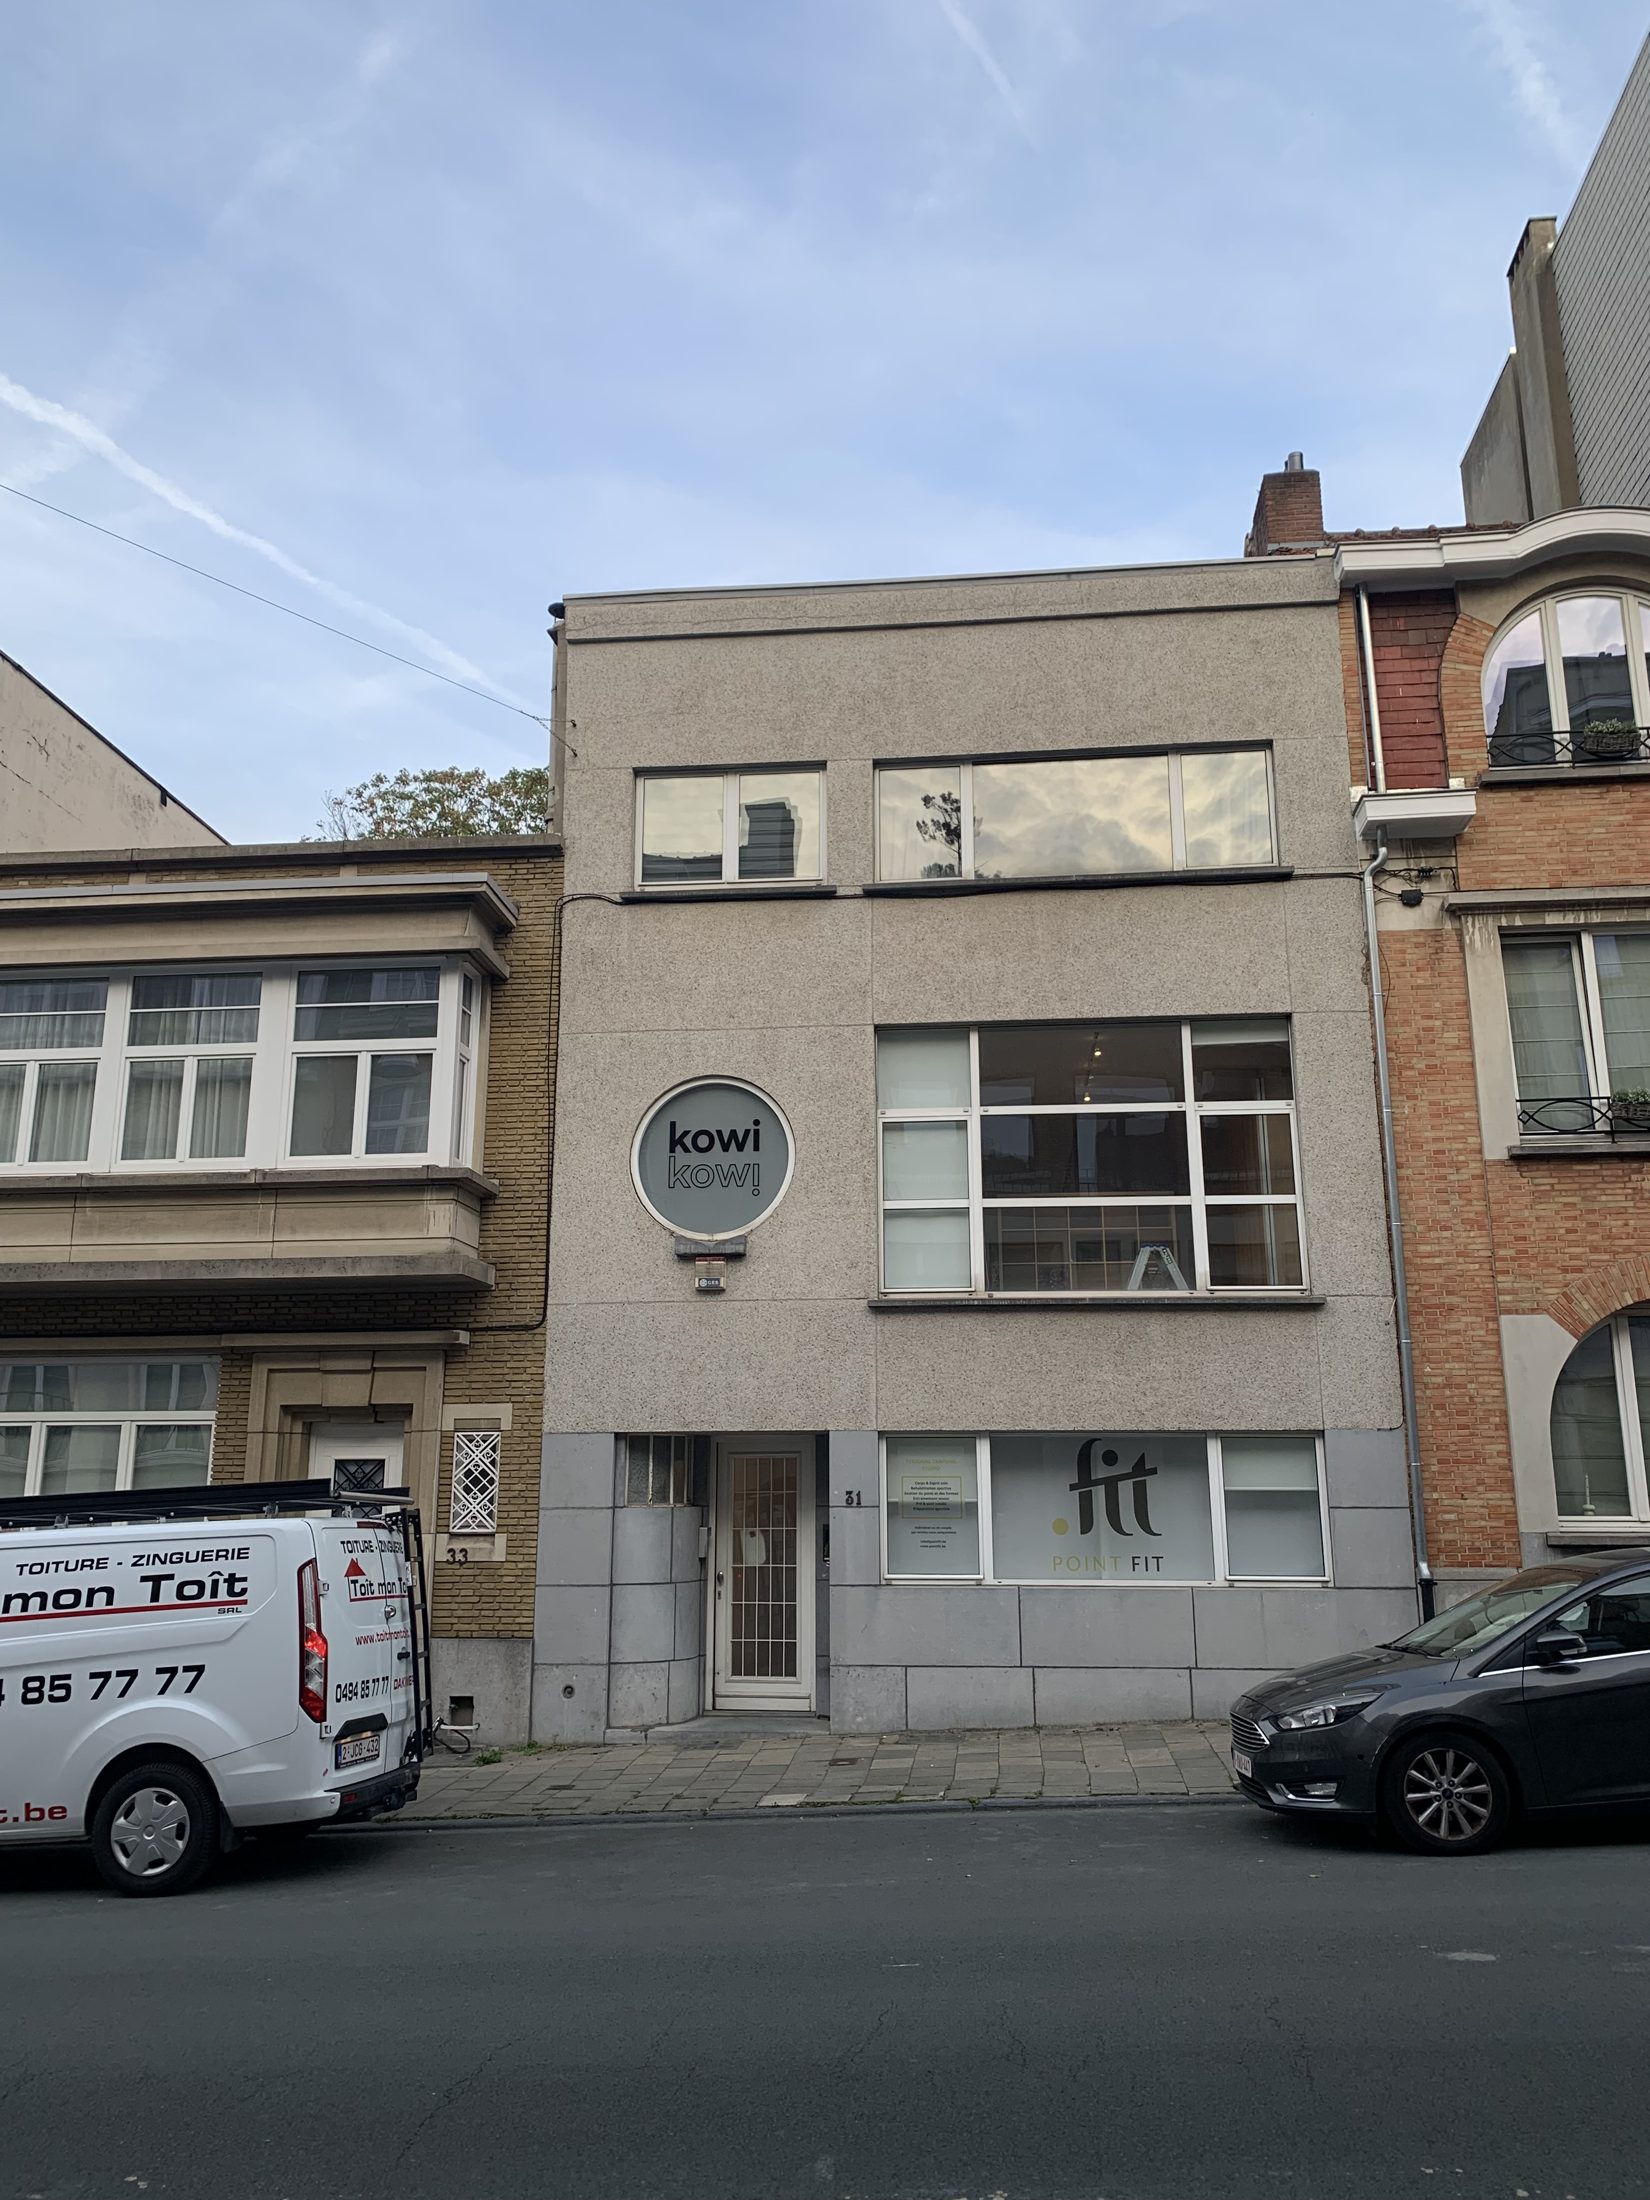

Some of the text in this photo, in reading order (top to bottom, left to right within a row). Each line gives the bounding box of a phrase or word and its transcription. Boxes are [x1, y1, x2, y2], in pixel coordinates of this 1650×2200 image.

[669, 1118, 760, 1154] kowi
[846, 1490, 861, 1505] 31
[340, 1540, 374, 1554] TOITURE
[446, 1547, 468, 1565] 33
[16, 1557, 110, 1576] TOITURE
[131, 1547, 250, 1568] ZINGUERIE
[1053, 1555, 1164, 1572] POINT FIT
[2, 1570, 248, 1615] mon Toît
[350, 1577, 407, 1597] Toît mon To
[217, 1607, 243, 1615] SRL
[21, 1673, 72, 1705] 85
[88, 1668, 139, 1700] 77
[155, 1664, 205, 1696] 77
[335, 1675, 389, 1703] 0494 85 77 77
[393, 1675, 414, 1690] DAKWE
